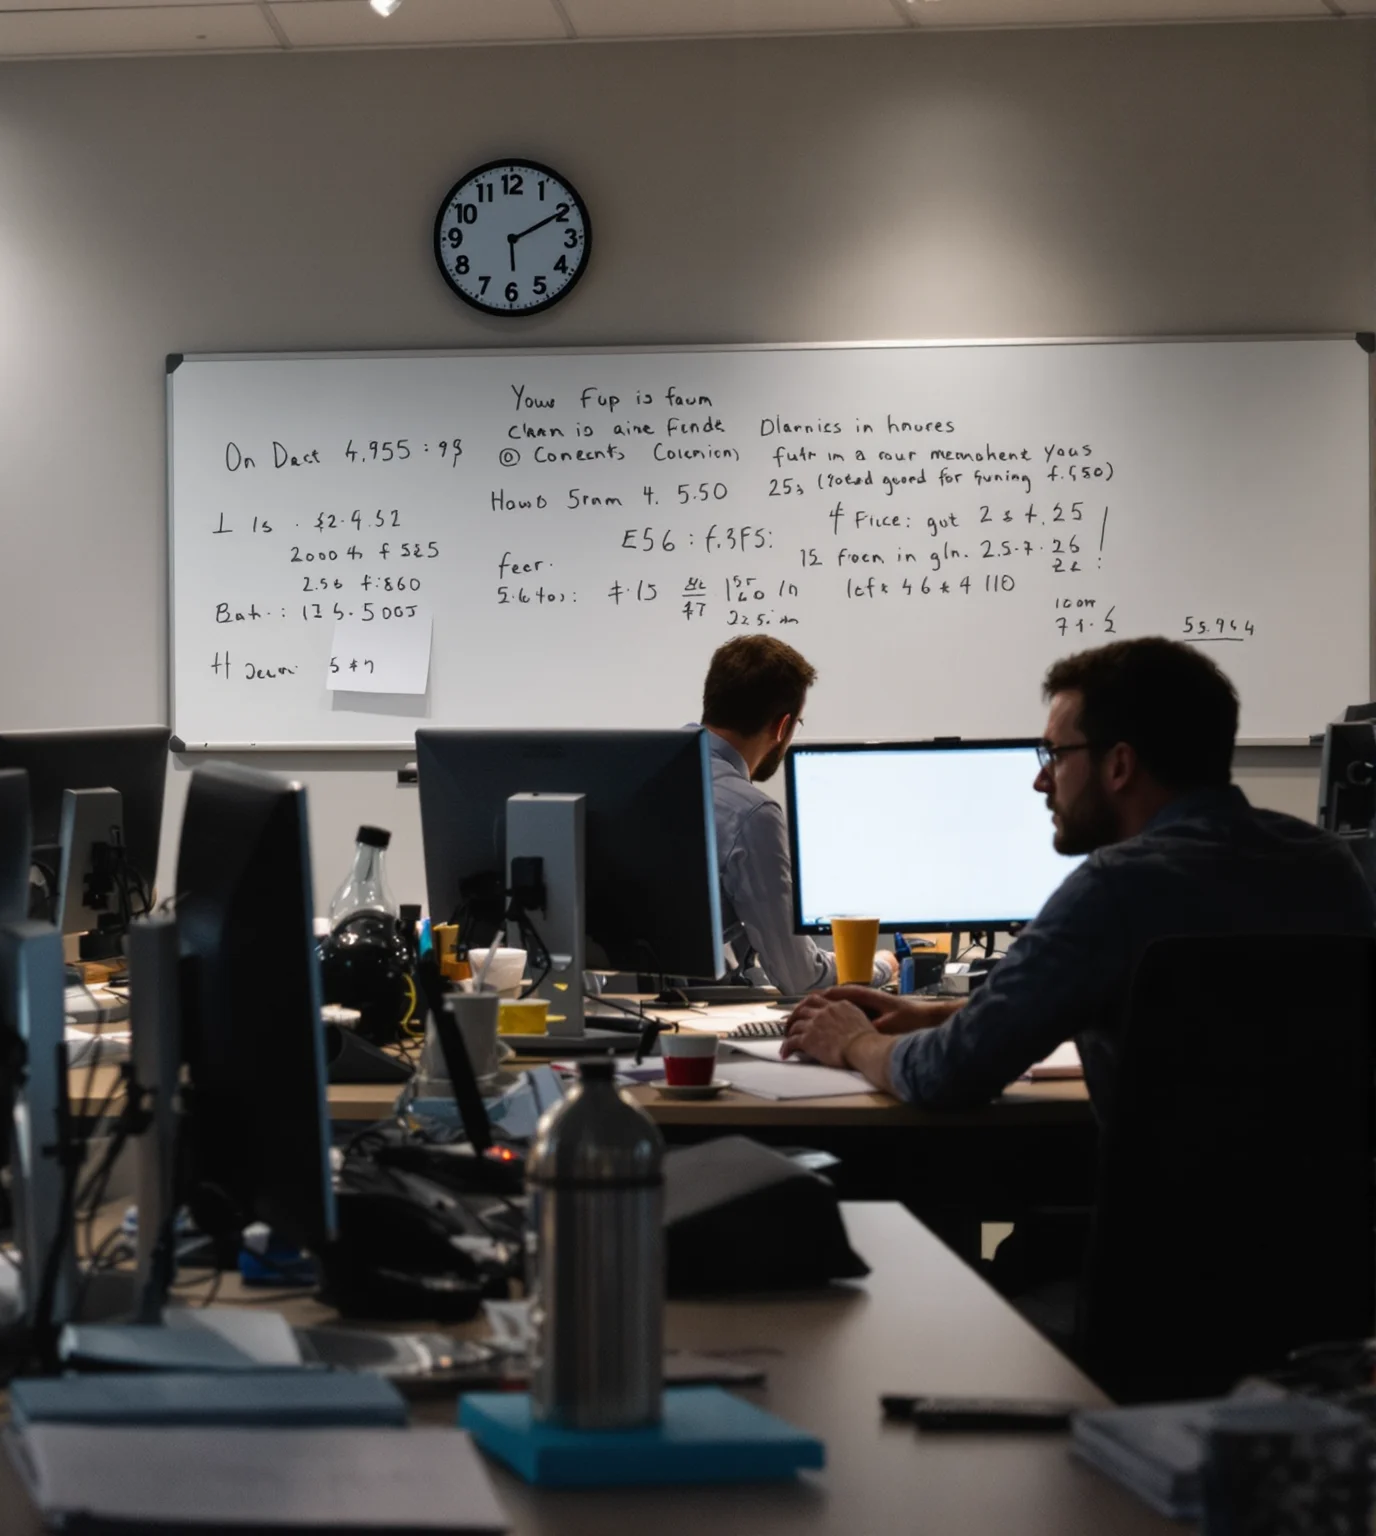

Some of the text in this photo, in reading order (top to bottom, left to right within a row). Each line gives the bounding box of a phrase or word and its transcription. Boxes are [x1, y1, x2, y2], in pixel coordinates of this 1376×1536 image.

[476, 183, 493, 202] 11
[501, 174, 524, 195] 12
[537, 180, 545, 201] 1
[455, 203, 477, 224] 10
[556, 203, 570, 222] 2
[448, 228, 463, 249] 9
[564, 229, 578, 248] 3
[455, 255, 470, 274] 8
[553, 255, 568, 274] 4
[478, 276, 492, 295] 7
[505, 282, 518, 302] 6
[533, 276, 547, 295] 5
[226, 442, 255, 471] On
[898, 547, 916, 562] in
